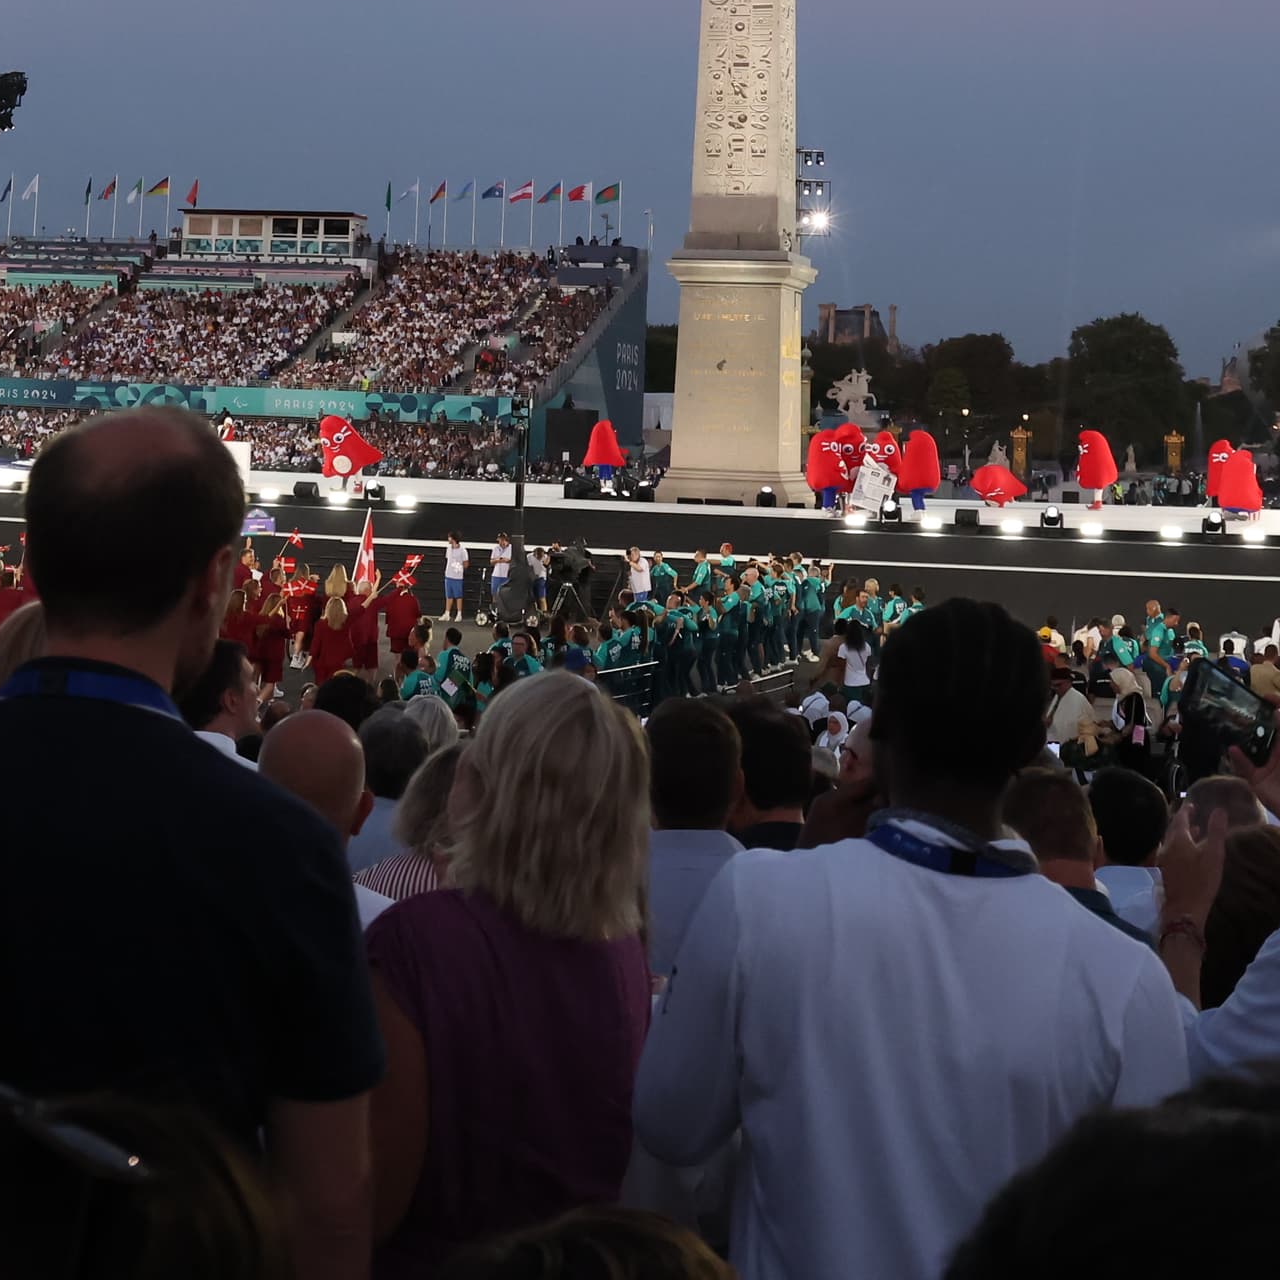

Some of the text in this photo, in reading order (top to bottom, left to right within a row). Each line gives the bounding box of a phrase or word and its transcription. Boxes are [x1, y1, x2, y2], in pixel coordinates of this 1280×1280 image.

[616, 341, 639, 366] PARIS
[615, 368, 638, 392] 2024
[23, 388, 57, 400] 2024
[274, 399, 355, 411] PARIS 2024
